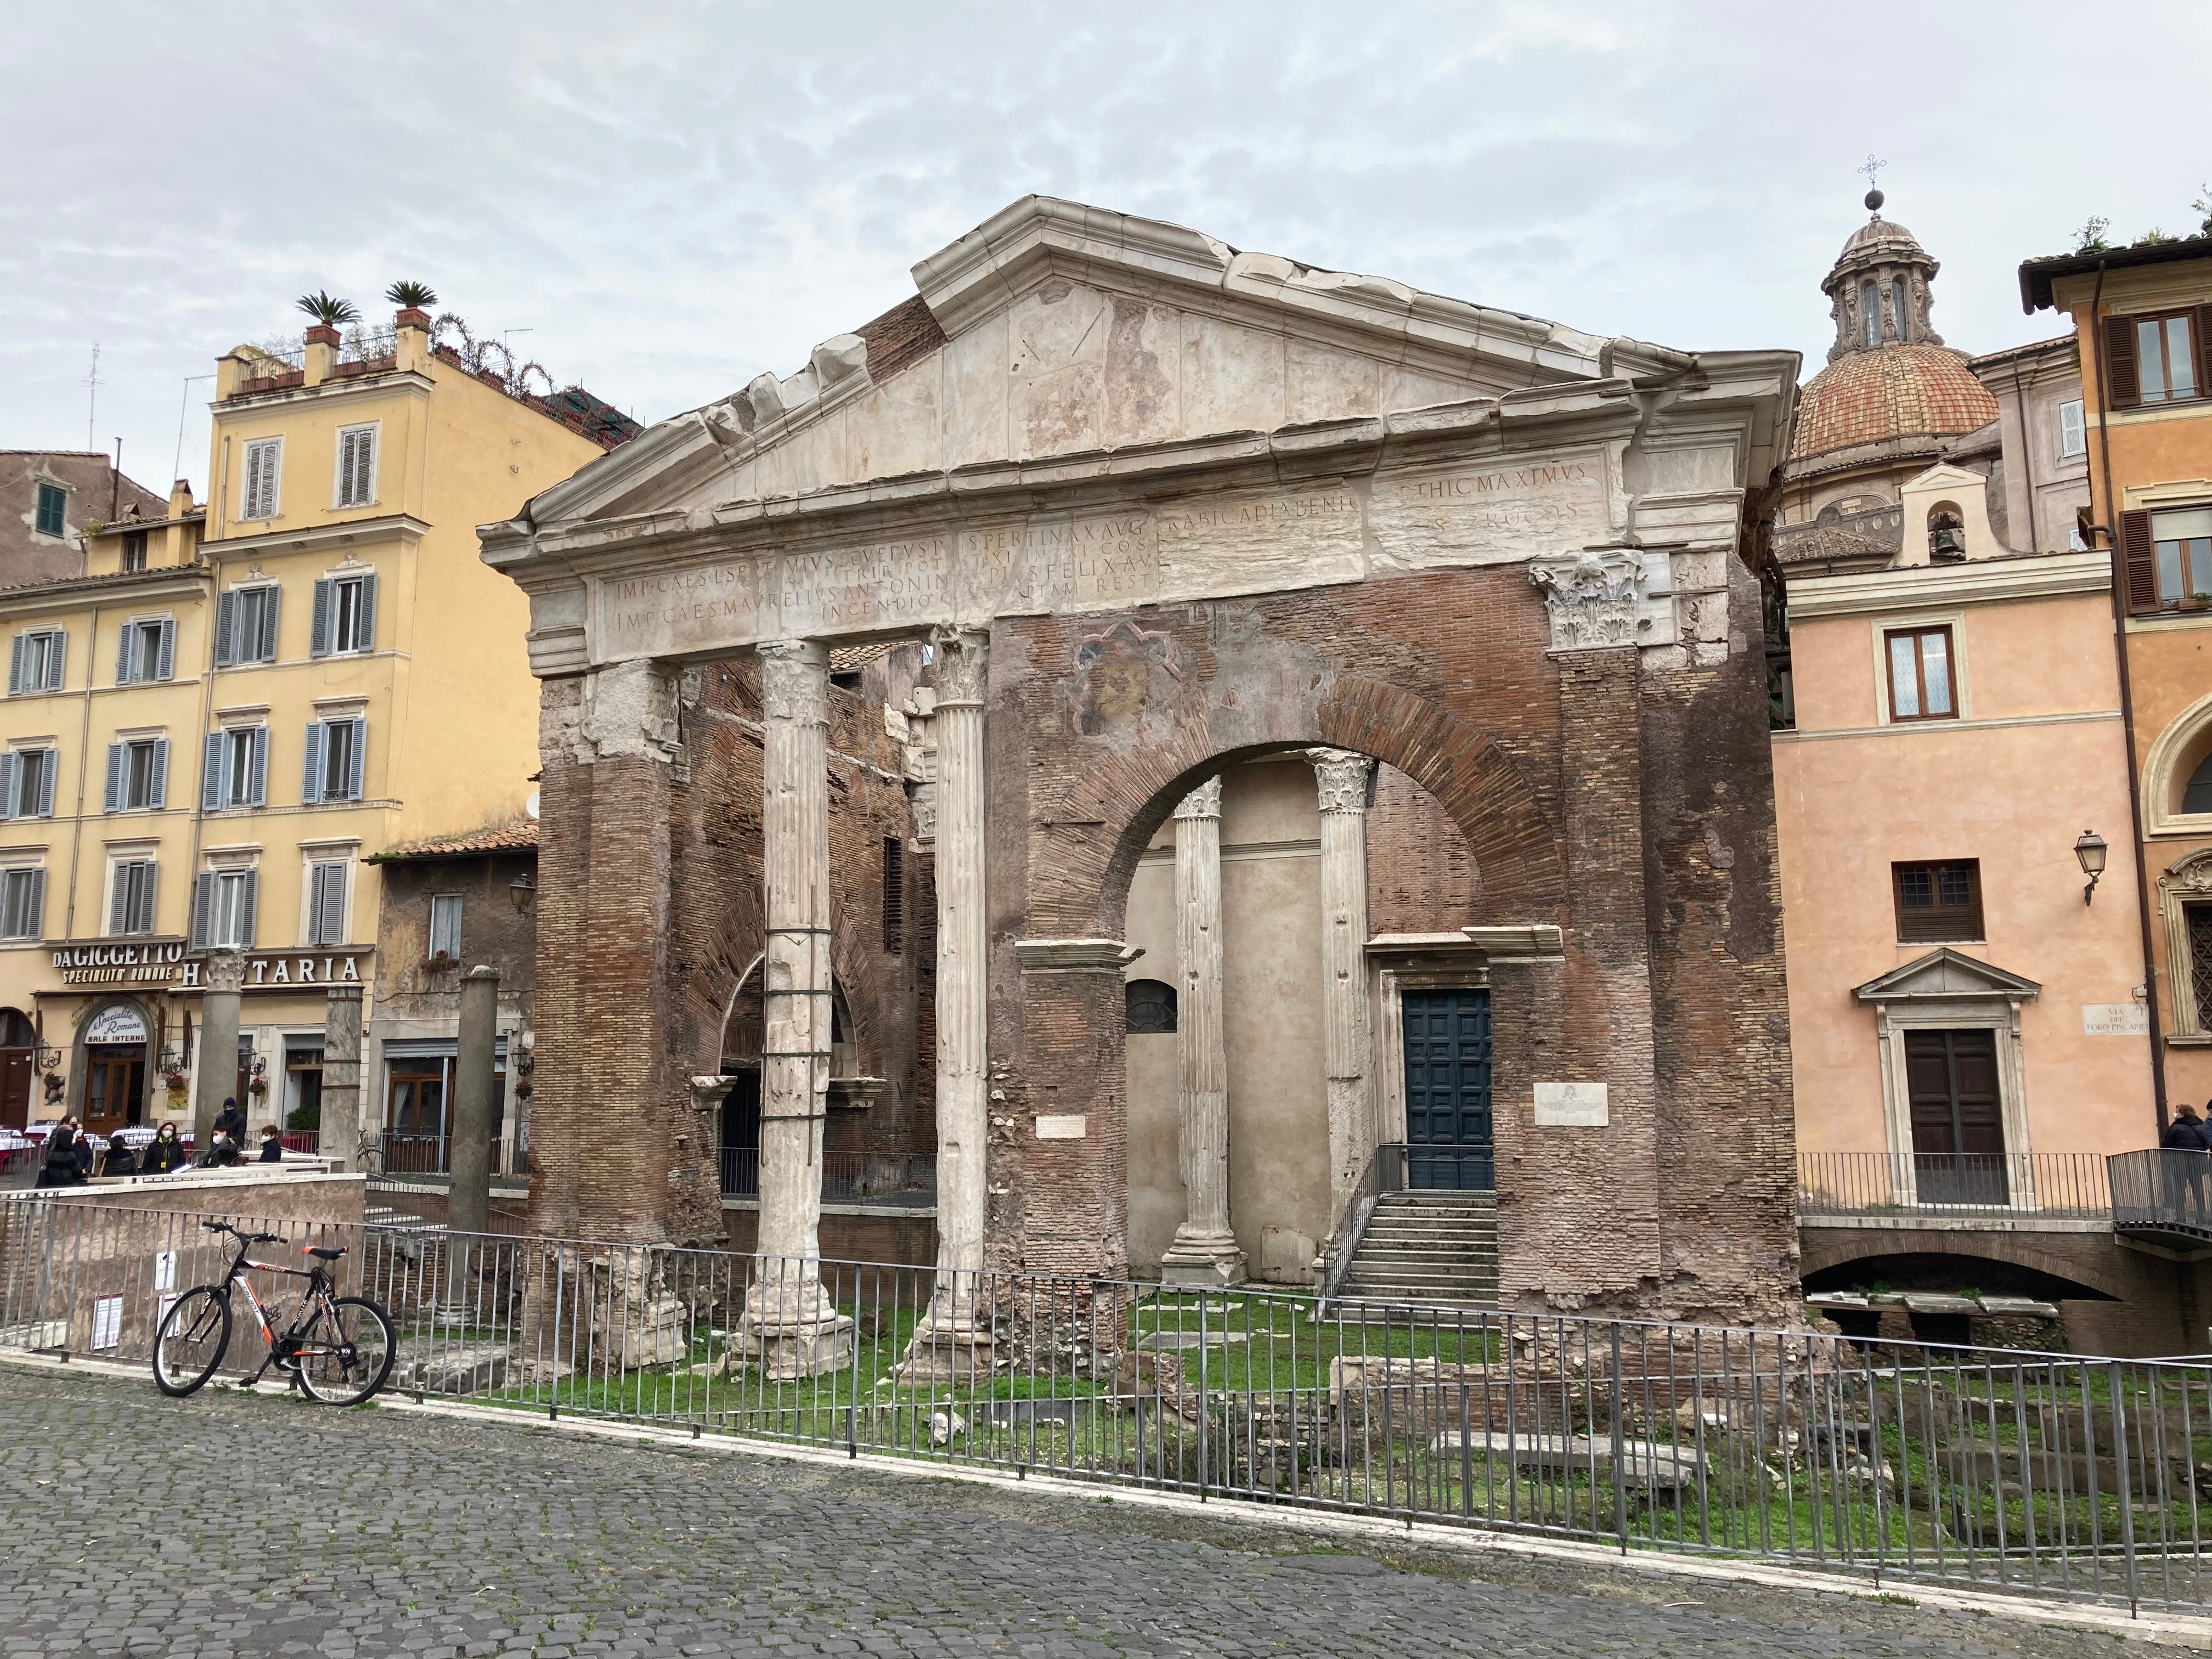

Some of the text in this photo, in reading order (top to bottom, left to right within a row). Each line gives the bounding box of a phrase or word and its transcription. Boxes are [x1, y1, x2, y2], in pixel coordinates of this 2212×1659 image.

[616, 580, 648, 599] IMP
[657, 571, 707, 592] CAES
[1102, 519, 1142, 539] AVG
[1477, 462, 1585, 493] MAXIMVS
[53, 943, 182, 968] DA GIGGETTO
[131, 967, 173, 981] ROMANE
[182, 957, 360, 986] HTARIA
[104, 1021, 142, 1035] Romane
